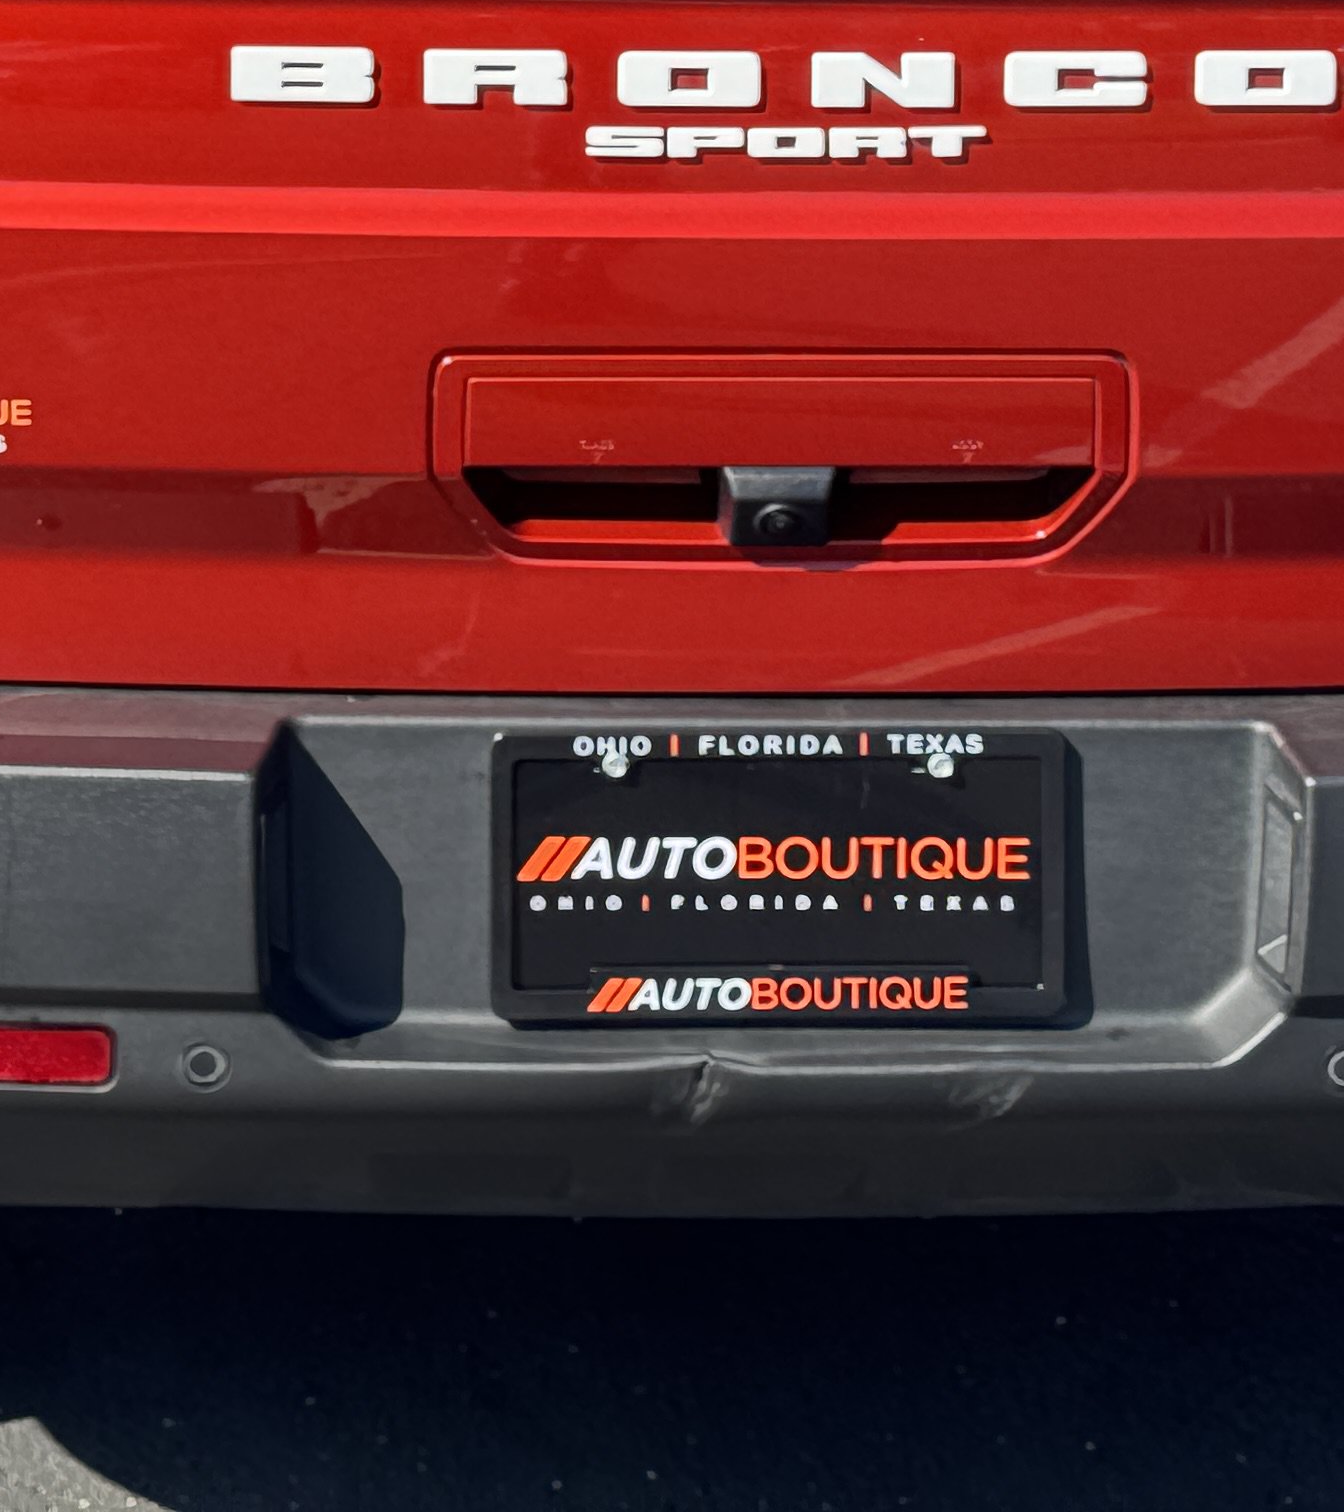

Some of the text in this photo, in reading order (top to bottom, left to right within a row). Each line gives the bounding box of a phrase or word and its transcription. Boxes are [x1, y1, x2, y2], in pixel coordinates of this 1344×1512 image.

[230, 44, 1340, 109] BRONCO
[585, 125, 988, 160] SPORT
[572, 733, 984, 757] OHIO FLORIDA TEXAS
[571, 835, 1031, 881] AUTOBOUTIQUE
[529, 894, 623, 911] OHIO
[670, 894, 838, 911] FLORIDA
[627, 975, 970, 1012] AUTOBOUTIQUE
